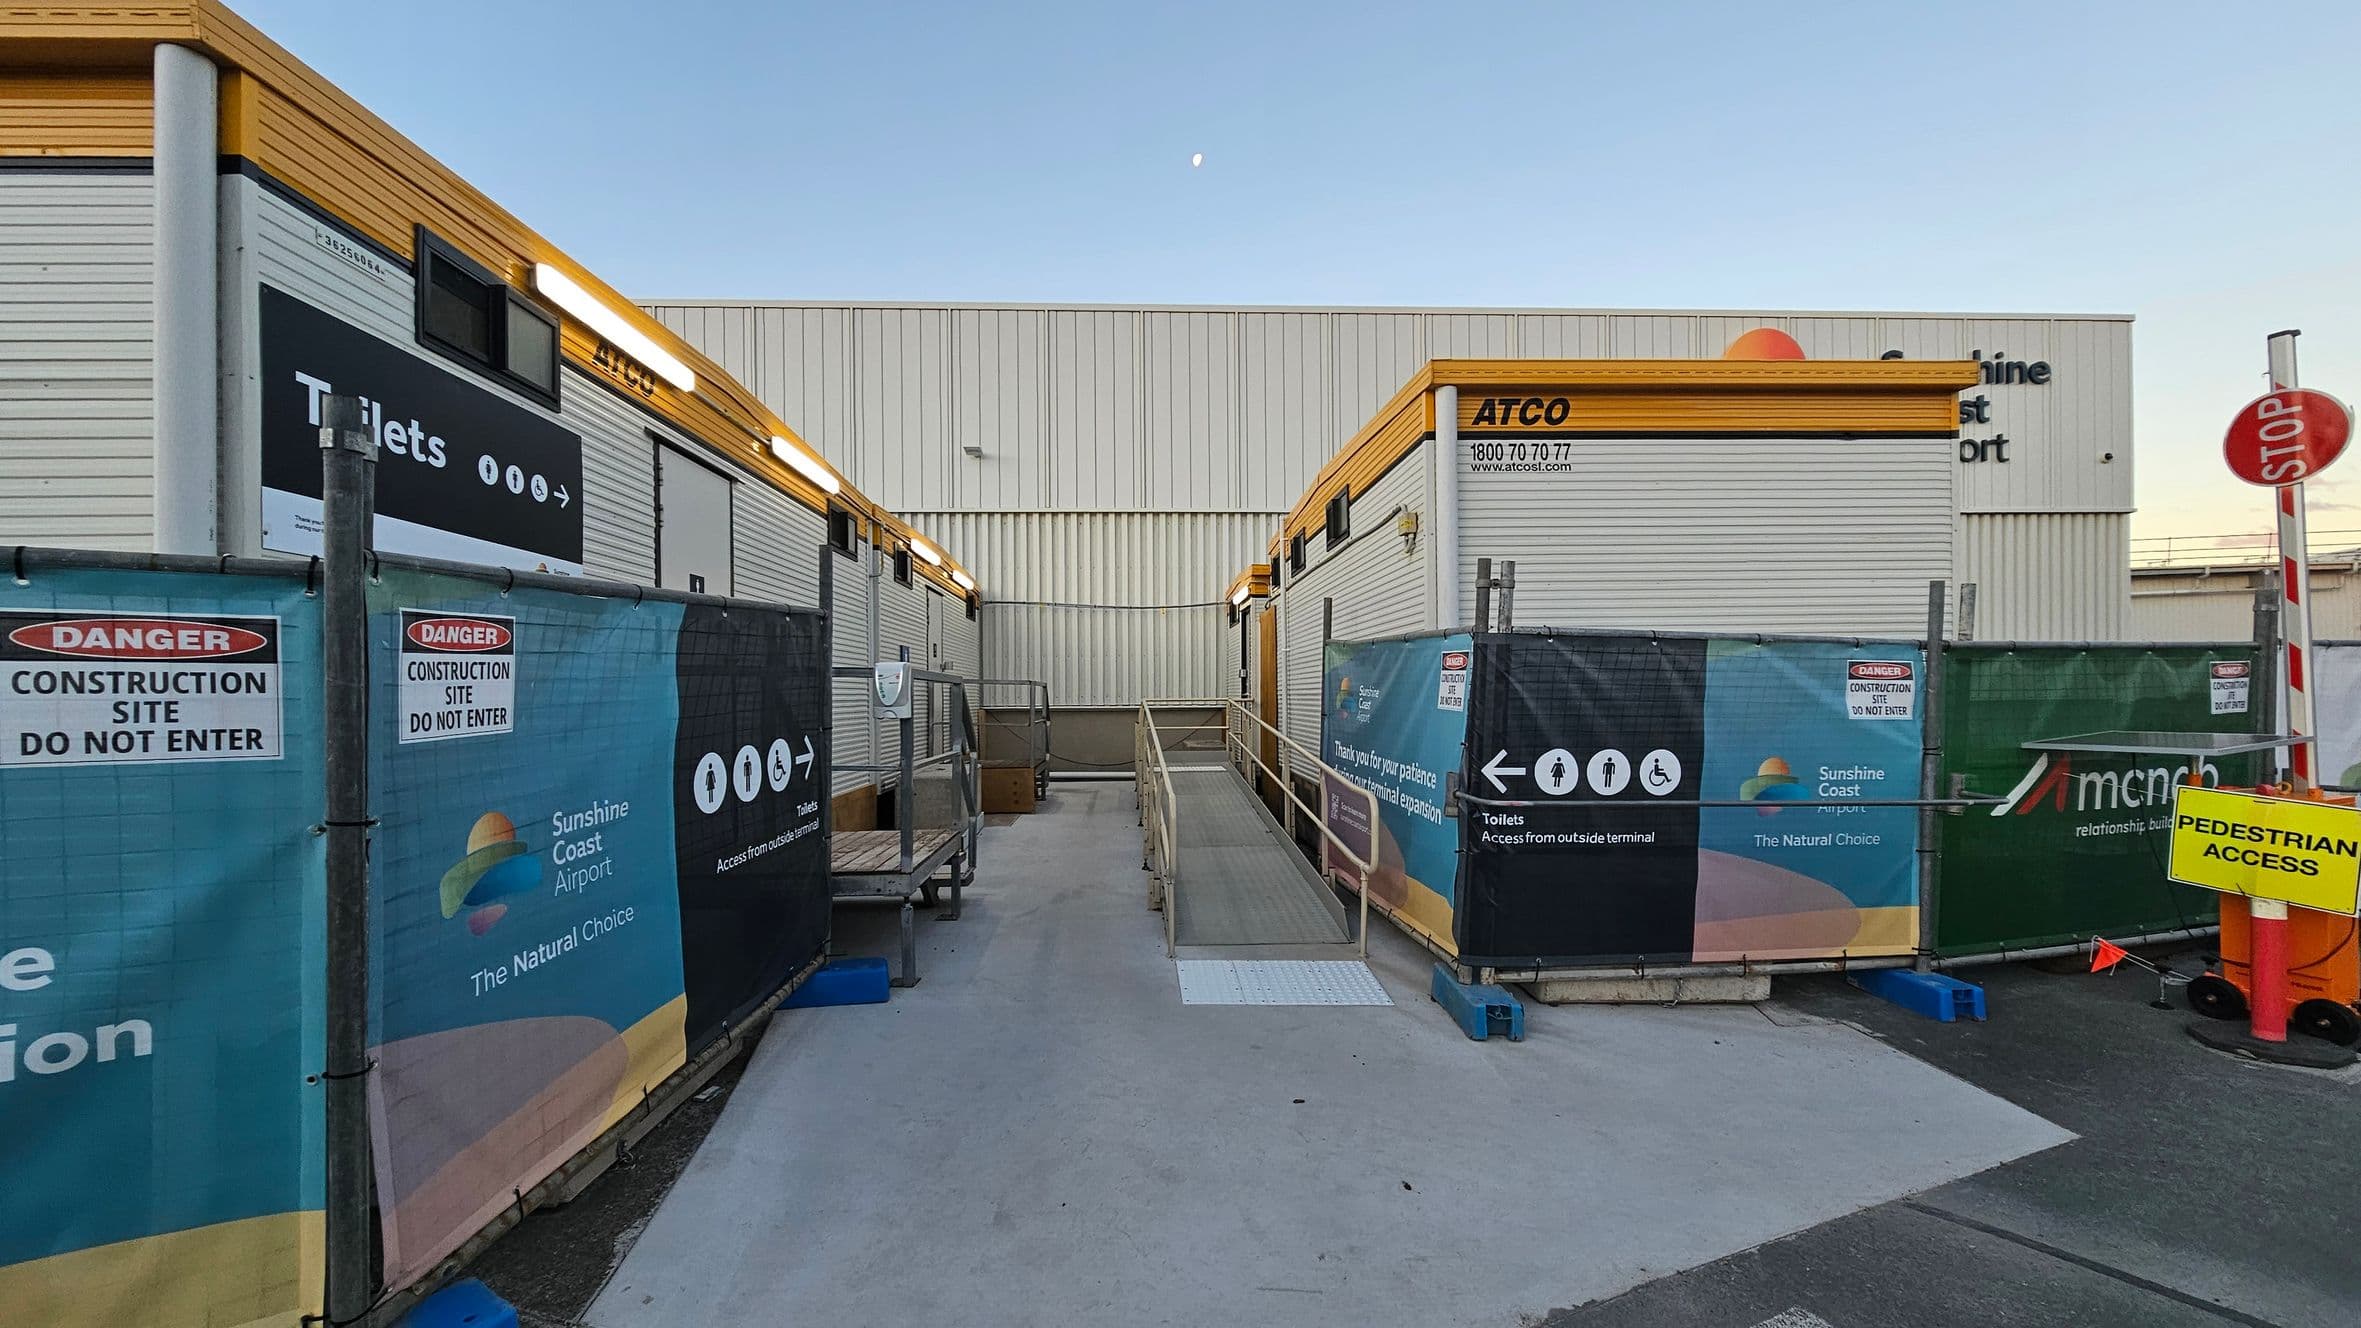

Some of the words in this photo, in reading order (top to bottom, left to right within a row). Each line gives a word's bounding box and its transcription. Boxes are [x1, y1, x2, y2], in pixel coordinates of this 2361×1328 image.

[295, 370, 447, 468] Tilets
[1471, 398, 1571, 426] ATCO
[2257, 397, 2308, 481] STOP
[1470, 443, 1504, 461] 1800
[1508, 443, 1527, 461] 70
[1531, 443, 1549, 461] 70
[1553, 443, 1571, 461] 77
[1470, 461, 1572, 472] www.atcosl.com
[52, 626, 231, 651] DANGER
[421, 624, 498, 645] DANGER
[11, 670, 267, 695] CONSTRUCTION
[407, 661, 510, 681] CONSTRUCTION
[1859, 666, 1901, 676] DANGER
[445, 685, 473, 705] SITE
[1850, 683, 1911, 693] CONSTRUCTION
[1872, 694, 1888, 704] SITE
[112, 700, 180, 724] SITE
[410, 712, 432, 733] DO
[436, 709, 463, 731] NOT
[467, 707, 507, 728] ENTER
[1852, 705, 1863, 715] DO
[1865, 705, 1882, 715] NOT
[1885, 705, 1908, 716] ENTER
[20, 731, 70, 756] DO
[84, 730, 152, 755] NOT
[167, 727, 264, 752] ENTER
[1334, 740, 1355, 761] Thank
[1355, 749, 1369, 767] you
[1369, 749, 1381, 770] for
[1381, 757, 1399, 776] your
[1399, 762, 1437, 789] patience
[1819, 765, 1885, 780] Sunshine
[1367, 777, 1399, 805] terminal
[1400, 792, 1442, 825] expansion
[1818, 783, 1861, 797] Coast
[552, 799, 629, 837] Sunshine
[796, 800, 818, 817] Toilets
[1482, 813, 1525, 826] Toilets
[1481, 831, 1524, 844] Access
[1525, 831, 1556, 844] from
[1557, 831, 1605, 844] outside
[1606, 831, 1656, 843] terminal
[1754, 834, 1779, 847] The
[1783, 833, 1832, 847] Natural
[1836, 832, 1880, 846] Choice
[2075, 818, 2146, 837] relationship
[2178, 814, 2358, 857] PEDESTRIAN
[553, 832, 603, 865] Coast
[716, 851, 747, 874] Access
[747, 842, 768, 860] from
[768, 830, 795, 850] outside
[794, 817, 820, 839] terminal
[2203, 843, 2320, 876] ACCESS
[554, 856, 613, 897] Airport
[470, 965, 508, 997] The
[513, 926, 578, 977] Natural
[582, 906, 635, 941] Choice
